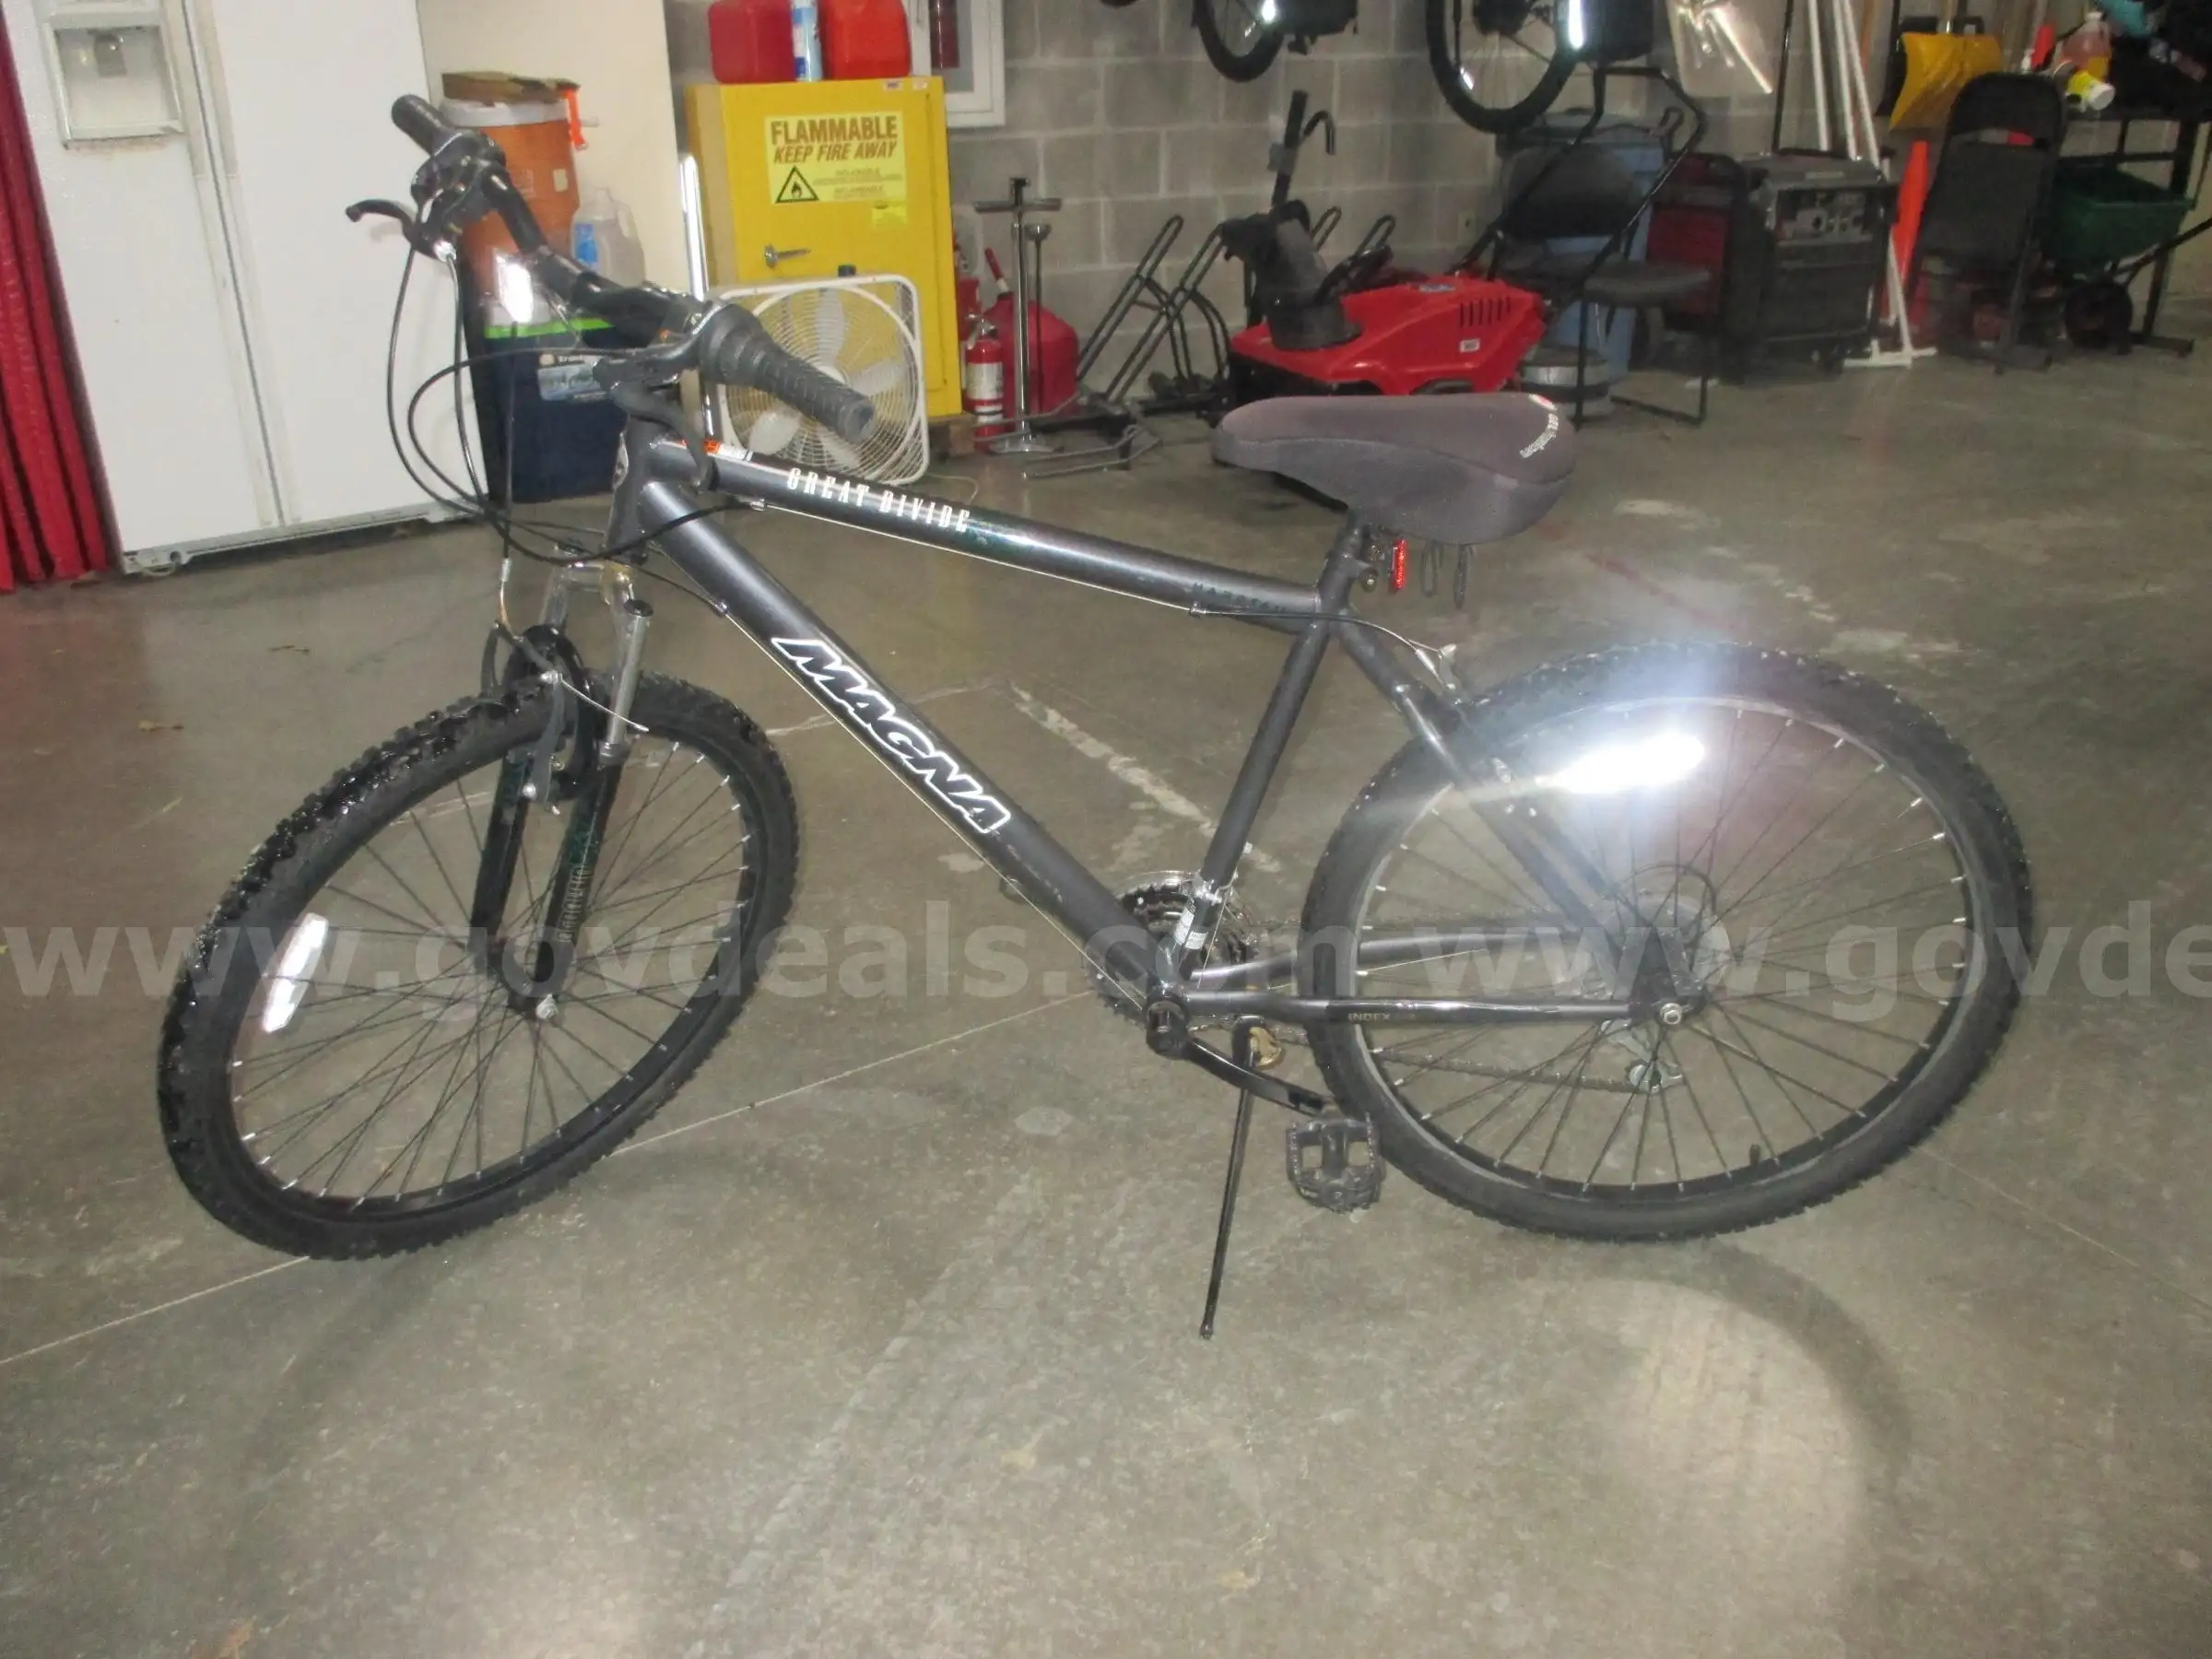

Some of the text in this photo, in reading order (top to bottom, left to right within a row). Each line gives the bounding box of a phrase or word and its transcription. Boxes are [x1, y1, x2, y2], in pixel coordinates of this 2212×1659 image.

[771, 116, 898, 144] FLAMMABLE
[773, 139, 898, 164] KEEP FIRE AWAY
[786, 467, 971, 532] GREAT DIVIDE
[771, 637, 1011, 833] MAGNA
[1347, 1012, 1391, 1021] INDEX
